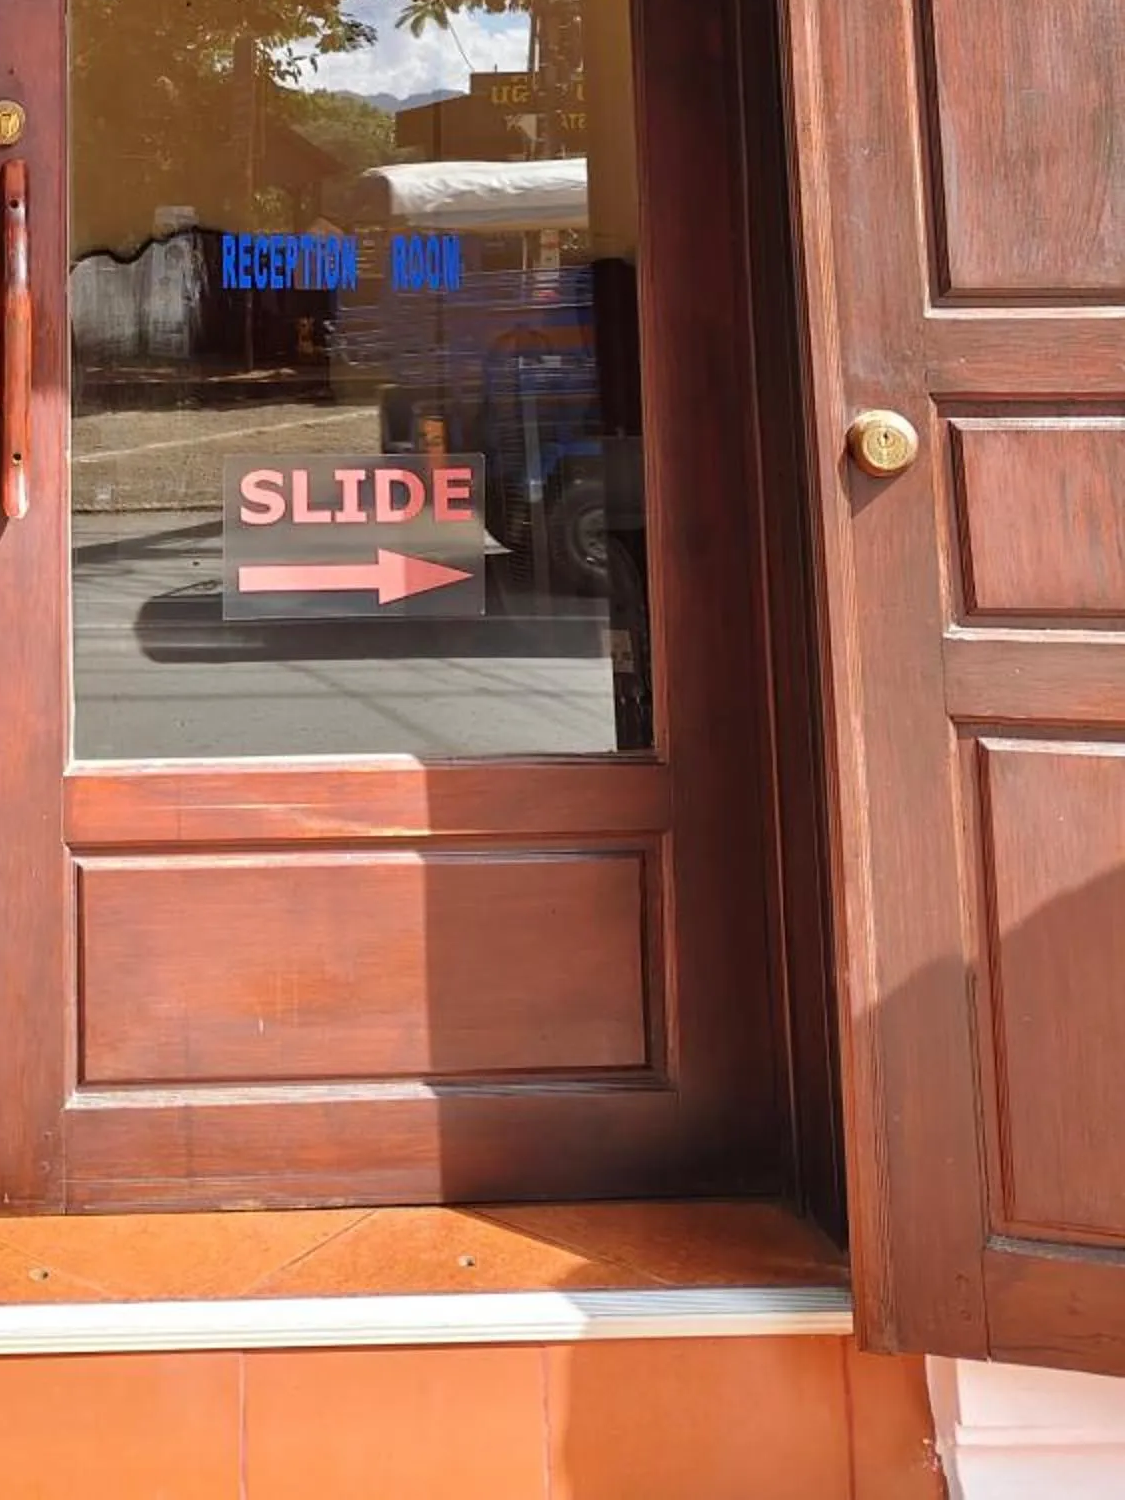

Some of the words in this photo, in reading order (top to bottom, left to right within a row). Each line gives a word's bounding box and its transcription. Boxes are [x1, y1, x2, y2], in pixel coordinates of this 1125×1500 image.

[221, 232, 359, 290] RECEPTION
[391, 234, 463, 291] ROOM
[238, 467, 475, 525] SLIDE
